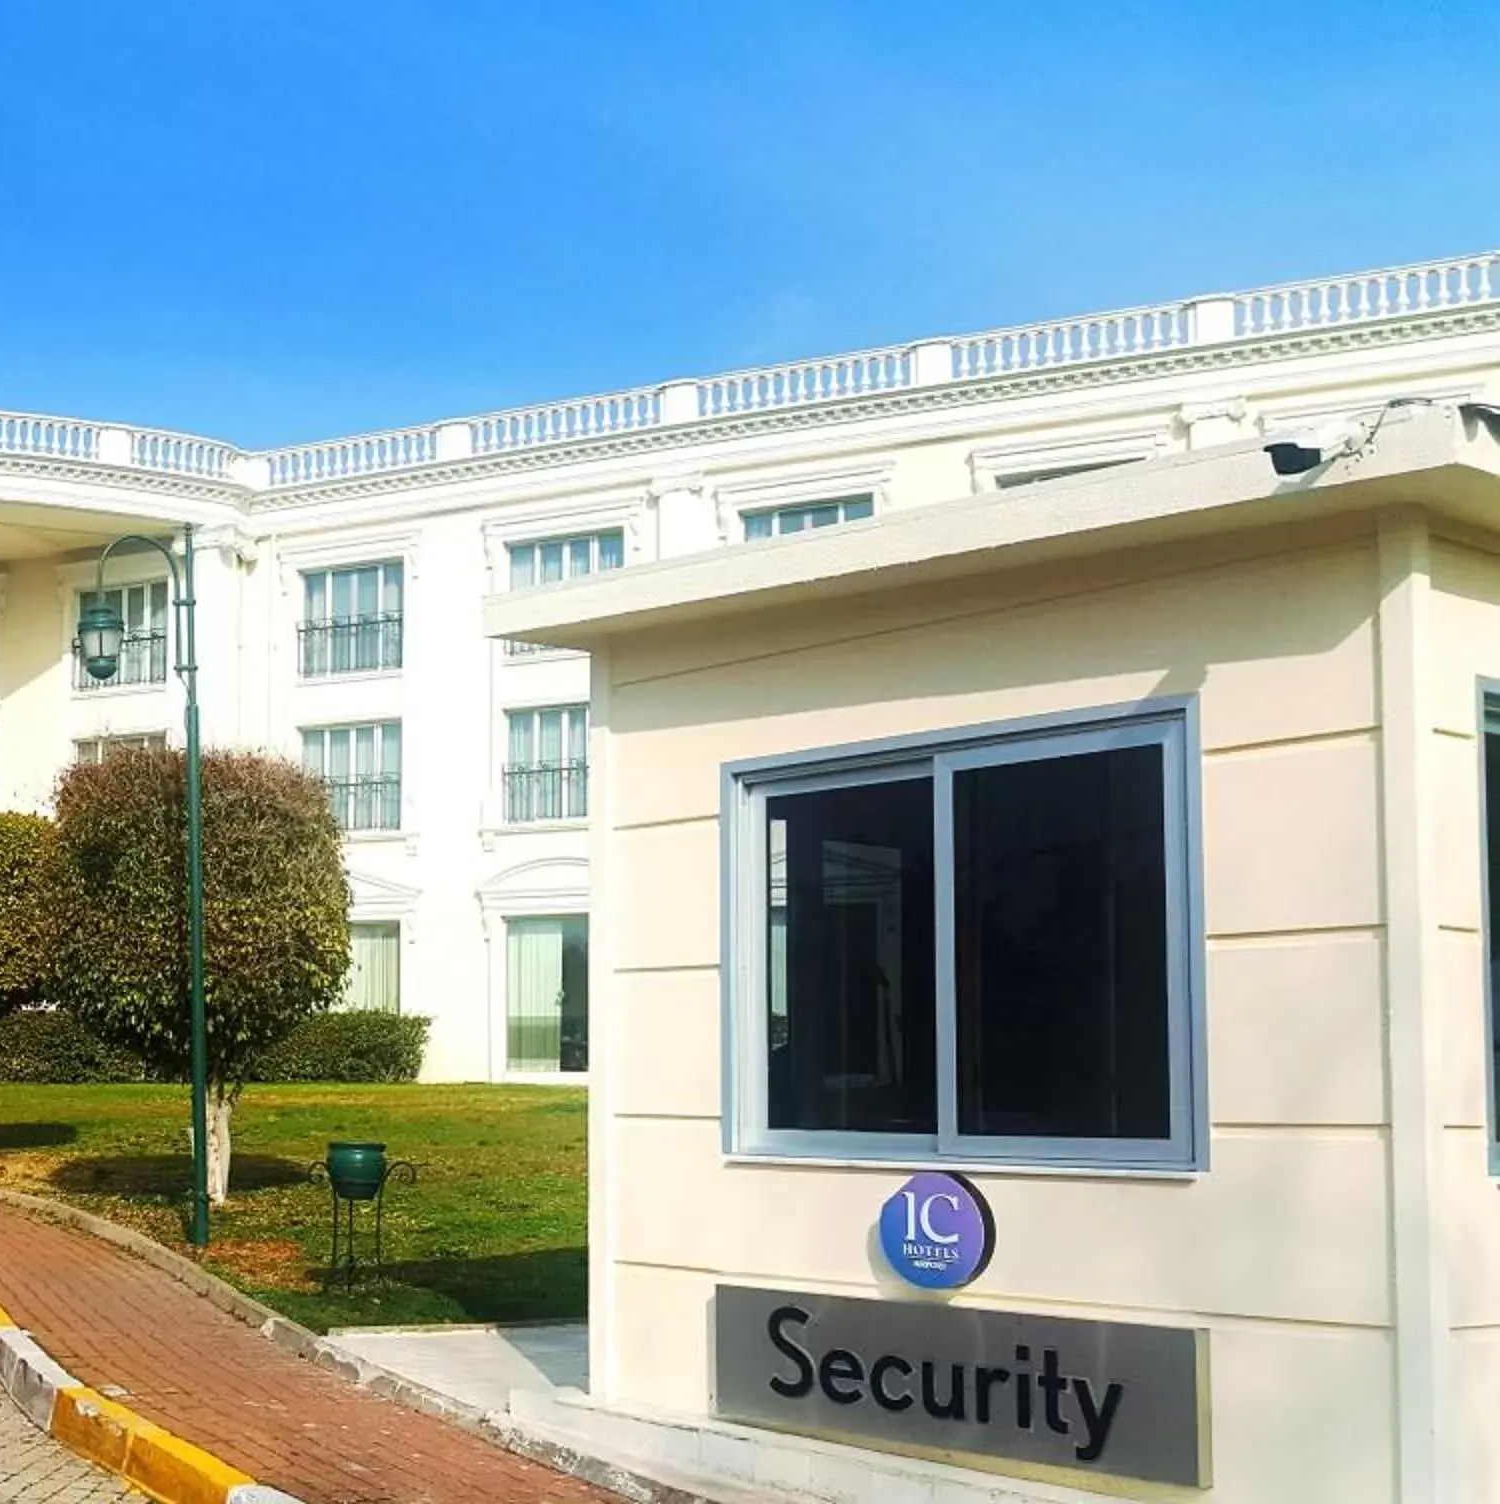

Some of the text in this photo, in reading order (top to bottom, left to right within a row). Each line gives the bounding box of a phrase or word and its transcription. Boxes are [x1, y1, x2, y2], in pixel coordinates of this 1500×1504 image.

[901, 1191, 960, 1244] IC
[902, 1243, 960, 1259] HOTELS
[767, 1306, 1124, 1462] Security
